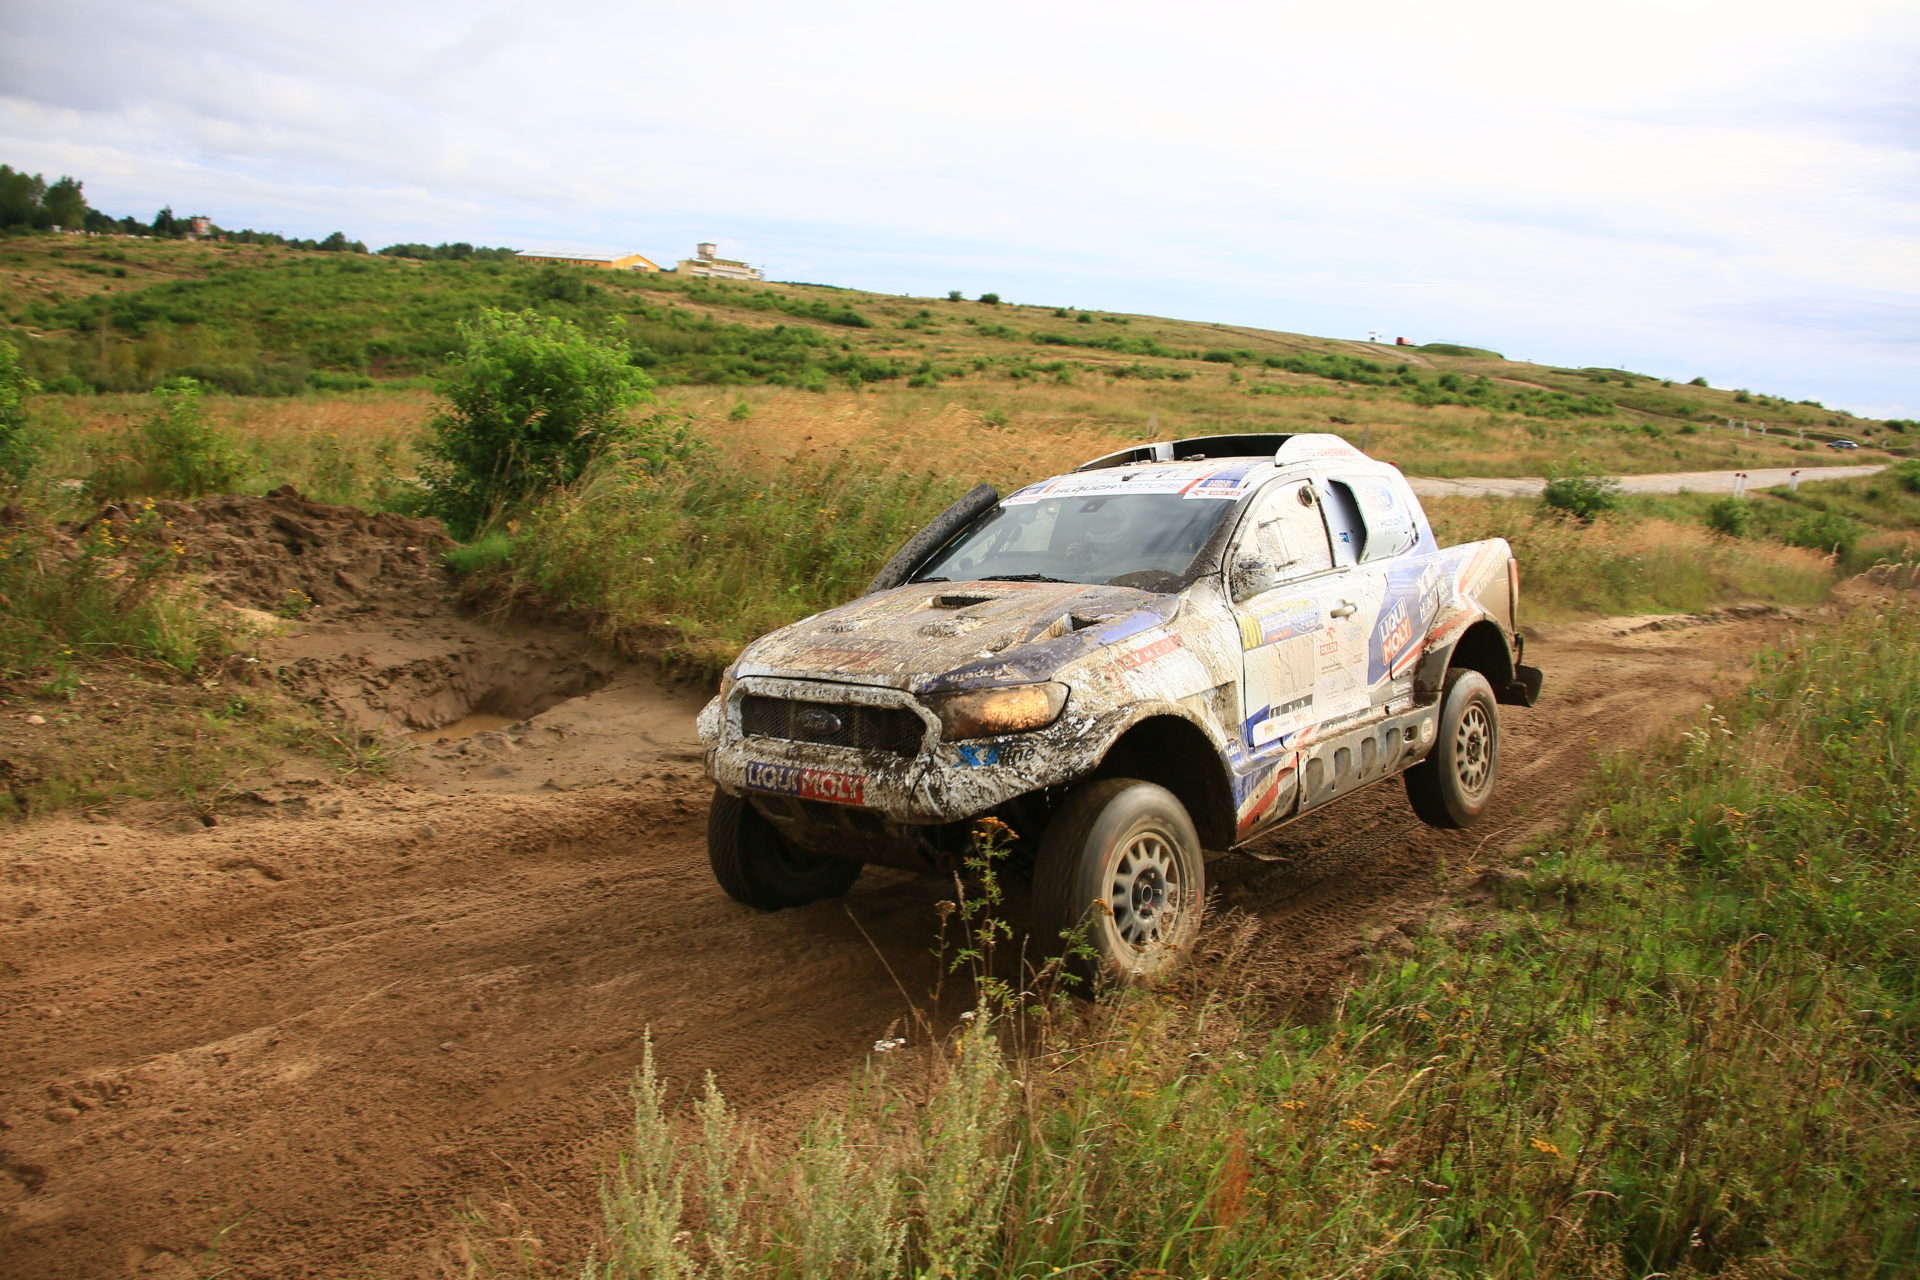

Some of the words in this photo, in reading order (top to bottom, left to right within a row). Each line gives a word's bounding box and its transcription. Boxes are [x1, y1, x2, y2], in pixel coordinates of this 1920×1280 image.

[1380, 601, 1407, 642] LIQUI
[1383, 620, 1410, 664] MOLY
[747, 763, 799, 791] LIQUI
[802, 771, 862, 799] MOLY
